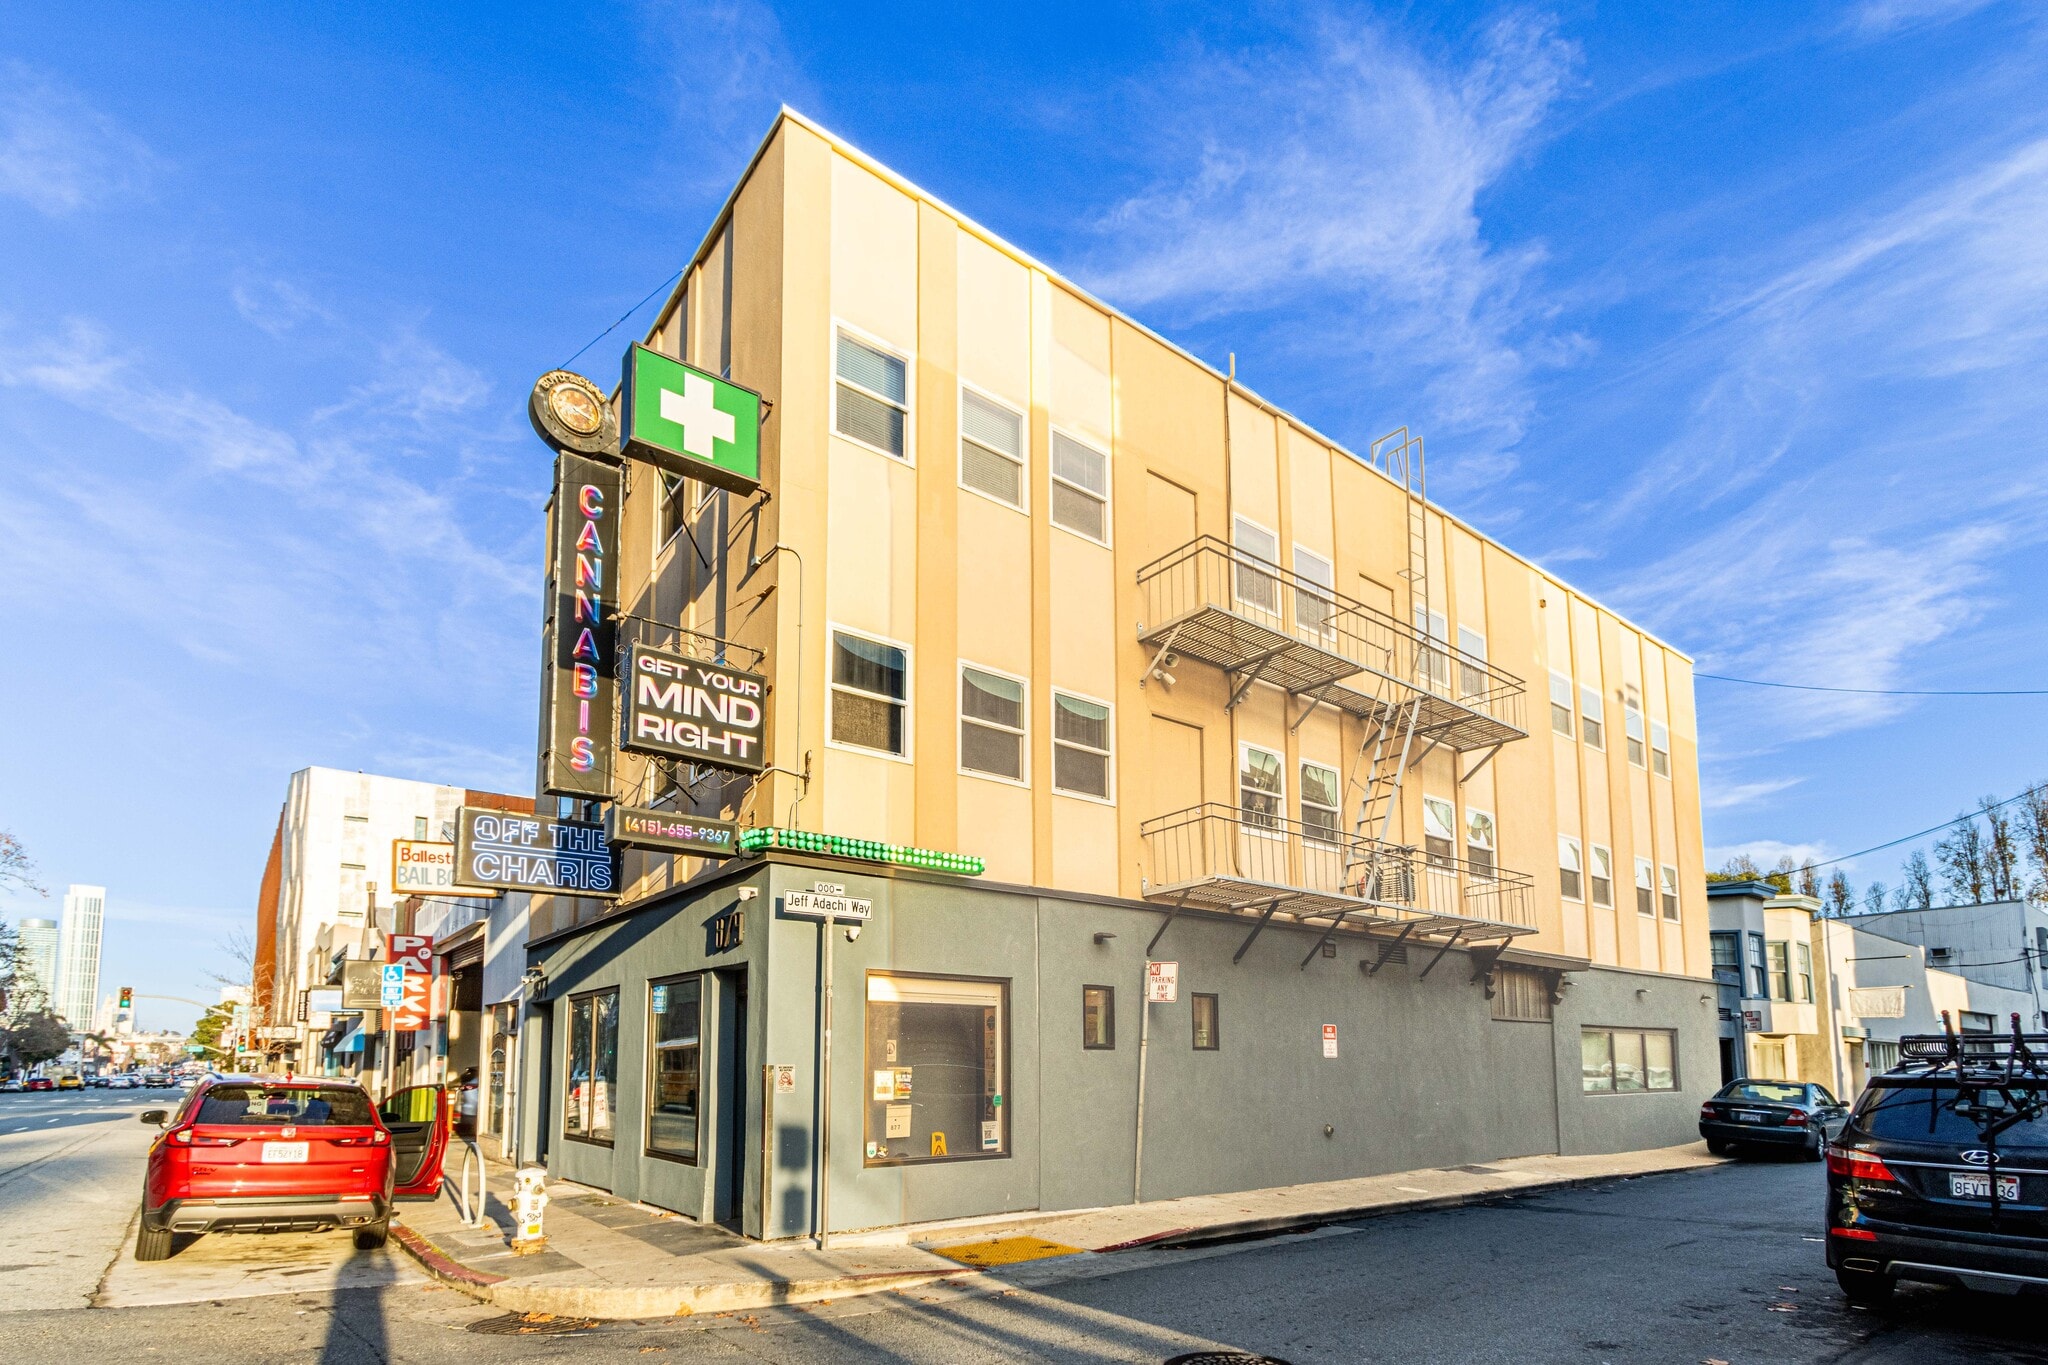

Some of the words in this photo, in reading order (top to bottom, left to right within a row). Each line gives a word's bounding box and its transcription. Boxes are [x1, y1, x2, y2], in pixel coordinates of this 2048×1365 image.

[570, 484, 605, 772] CANNABIS
[638, 655, 689, 680] GET
[697, 668, 761, 698] YOUR
[638, 674, 761, 729] MIND
[637, 712, 758, 759] RIGHT
[474, 815, 540, 845] OFF
[548, 824, 610, 854] THE
[398, 865, 432, 885] BAIL
[472, 852, 612, 890] CHARTS
[788, 893, 808, 908] Jeff
[812, 896, 847, 912] Adachi
[851, 900, 870, 916] Way
[1151, 964, 1160, 975] NO
[1151, 976, 1175, 985] PARKING
[1156, 992, 1169, 1000] TIME
[1954, 1182, 2016, 1198] 8EVT36
